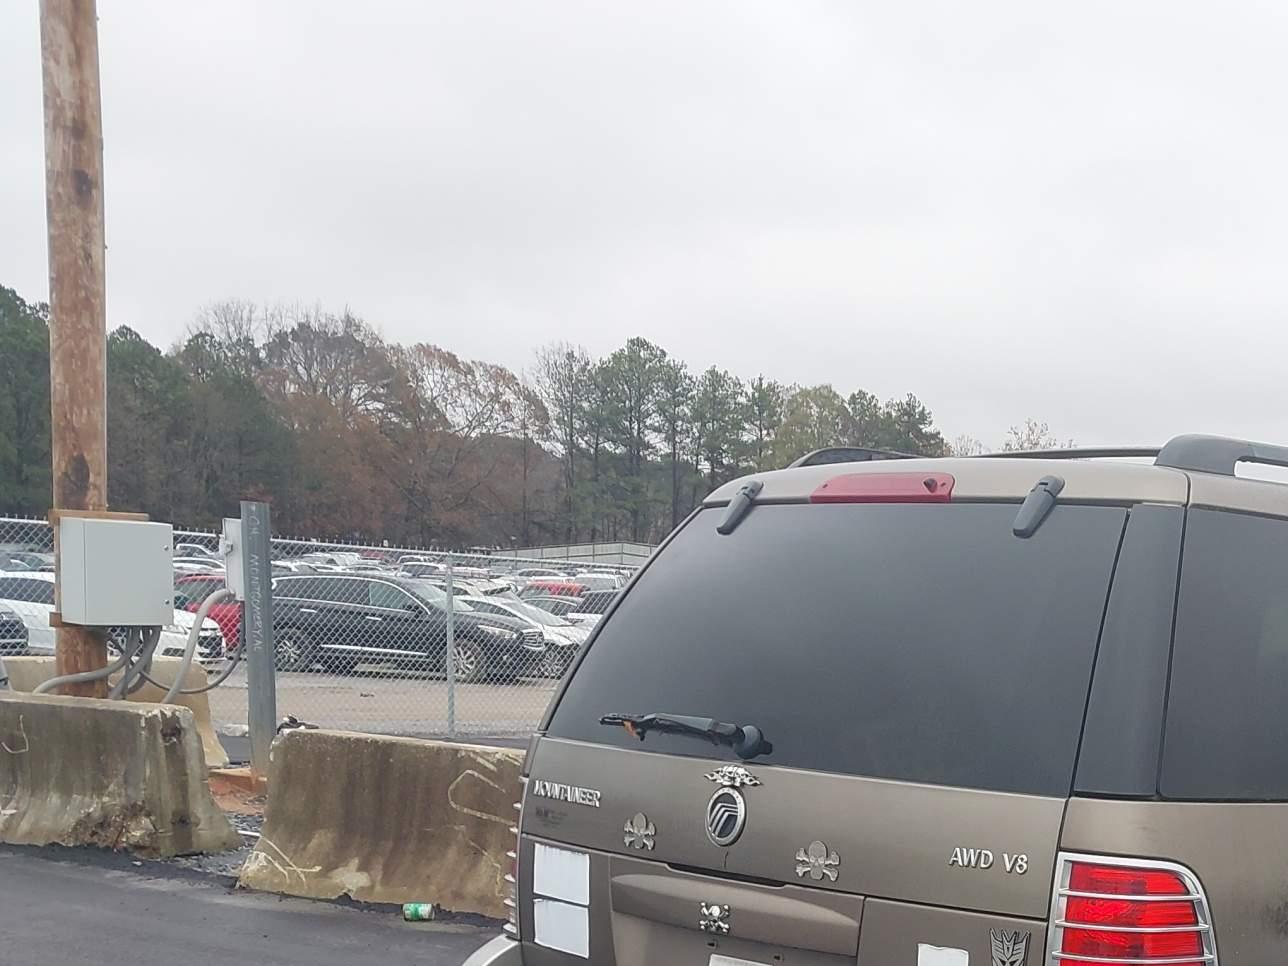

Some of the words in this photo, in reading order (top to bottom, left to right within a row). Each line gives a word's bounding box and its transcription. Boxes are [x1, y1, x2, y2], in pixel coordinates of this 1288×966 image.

[533, 780, 601, 807] MOUNTAINEER
[950, 847, 993, 869] AWD
[1003, 853, 1028, 874] V8
